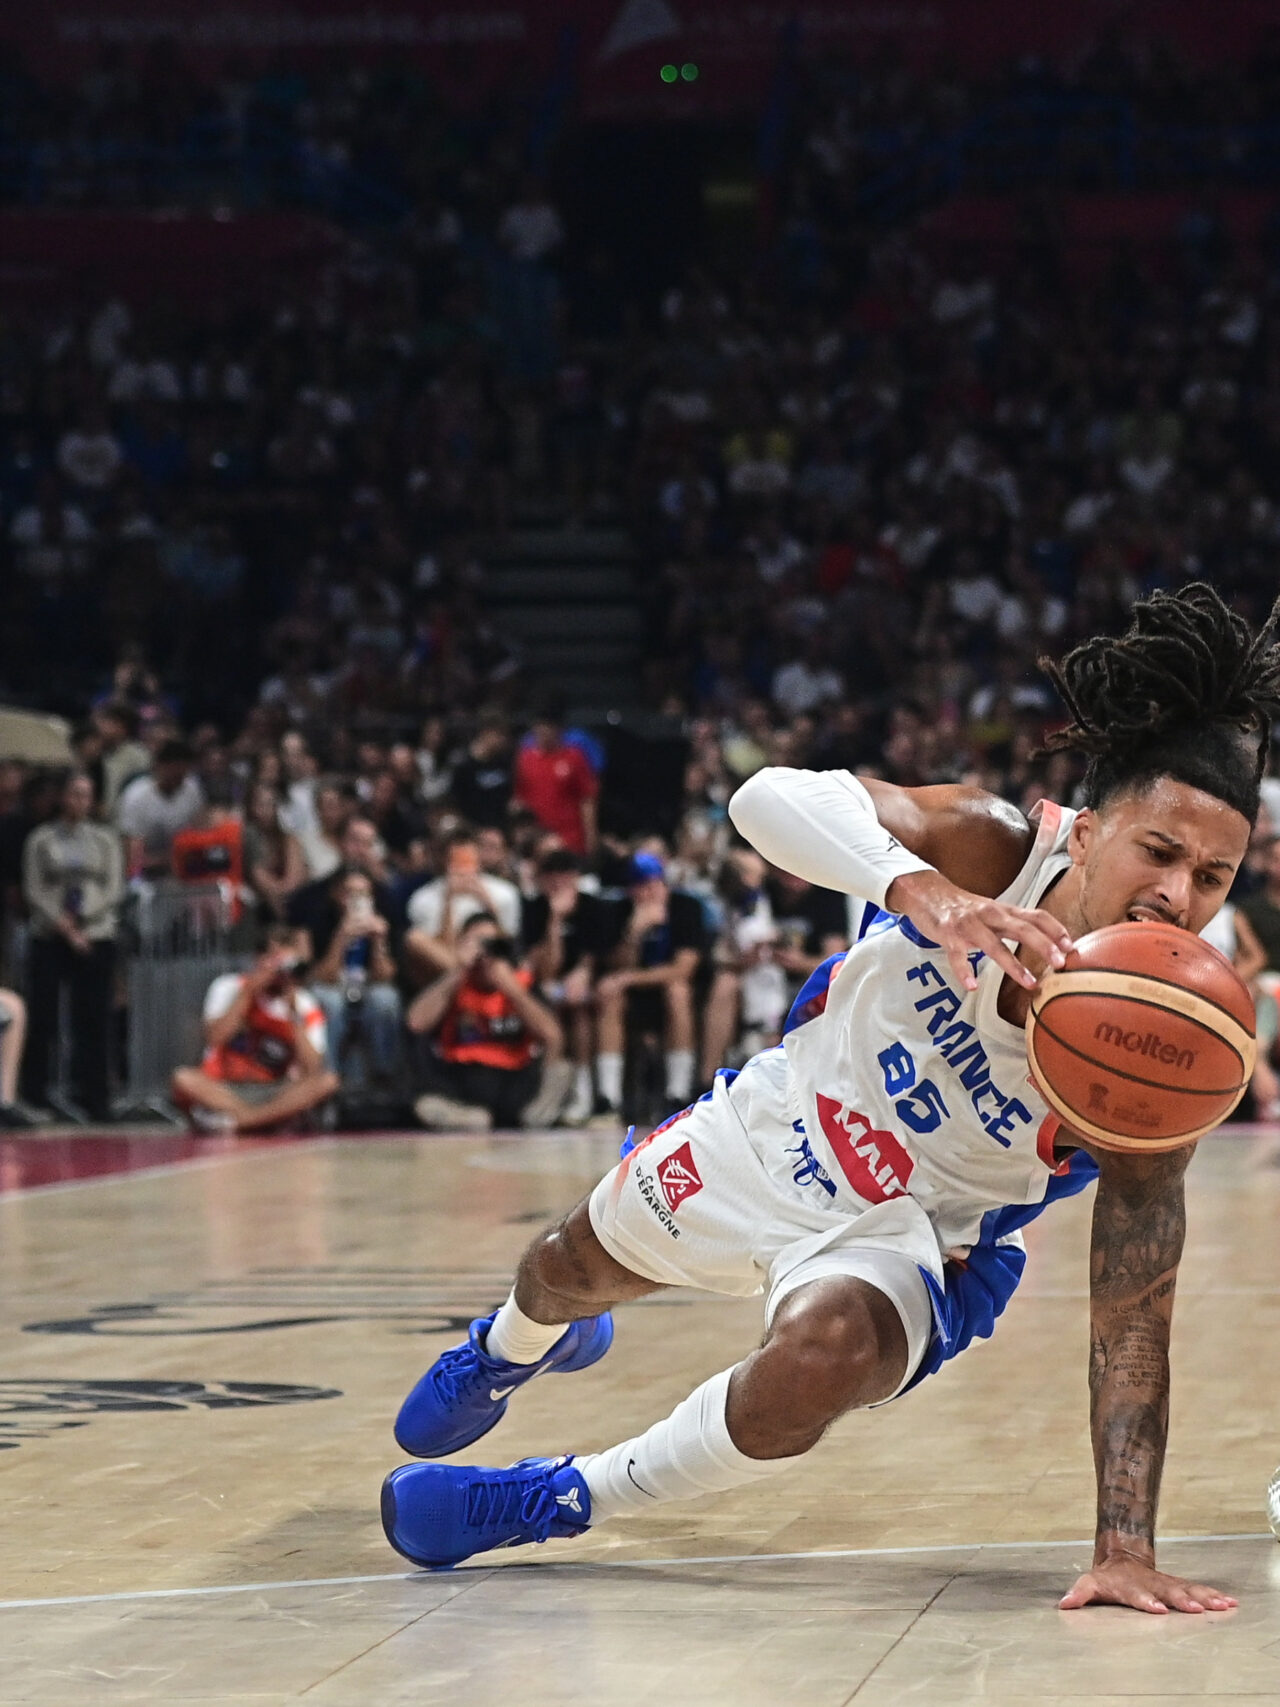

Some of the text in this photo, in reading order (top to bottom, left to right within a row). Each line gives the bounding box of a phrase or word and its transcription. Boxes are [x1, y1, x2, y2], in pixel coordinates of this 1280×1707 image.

[877, 1041, 951, 1134] 85
[906, 960, 1033, 1149] FRANCE
[1093, 1022, 1195, 1071] molten
